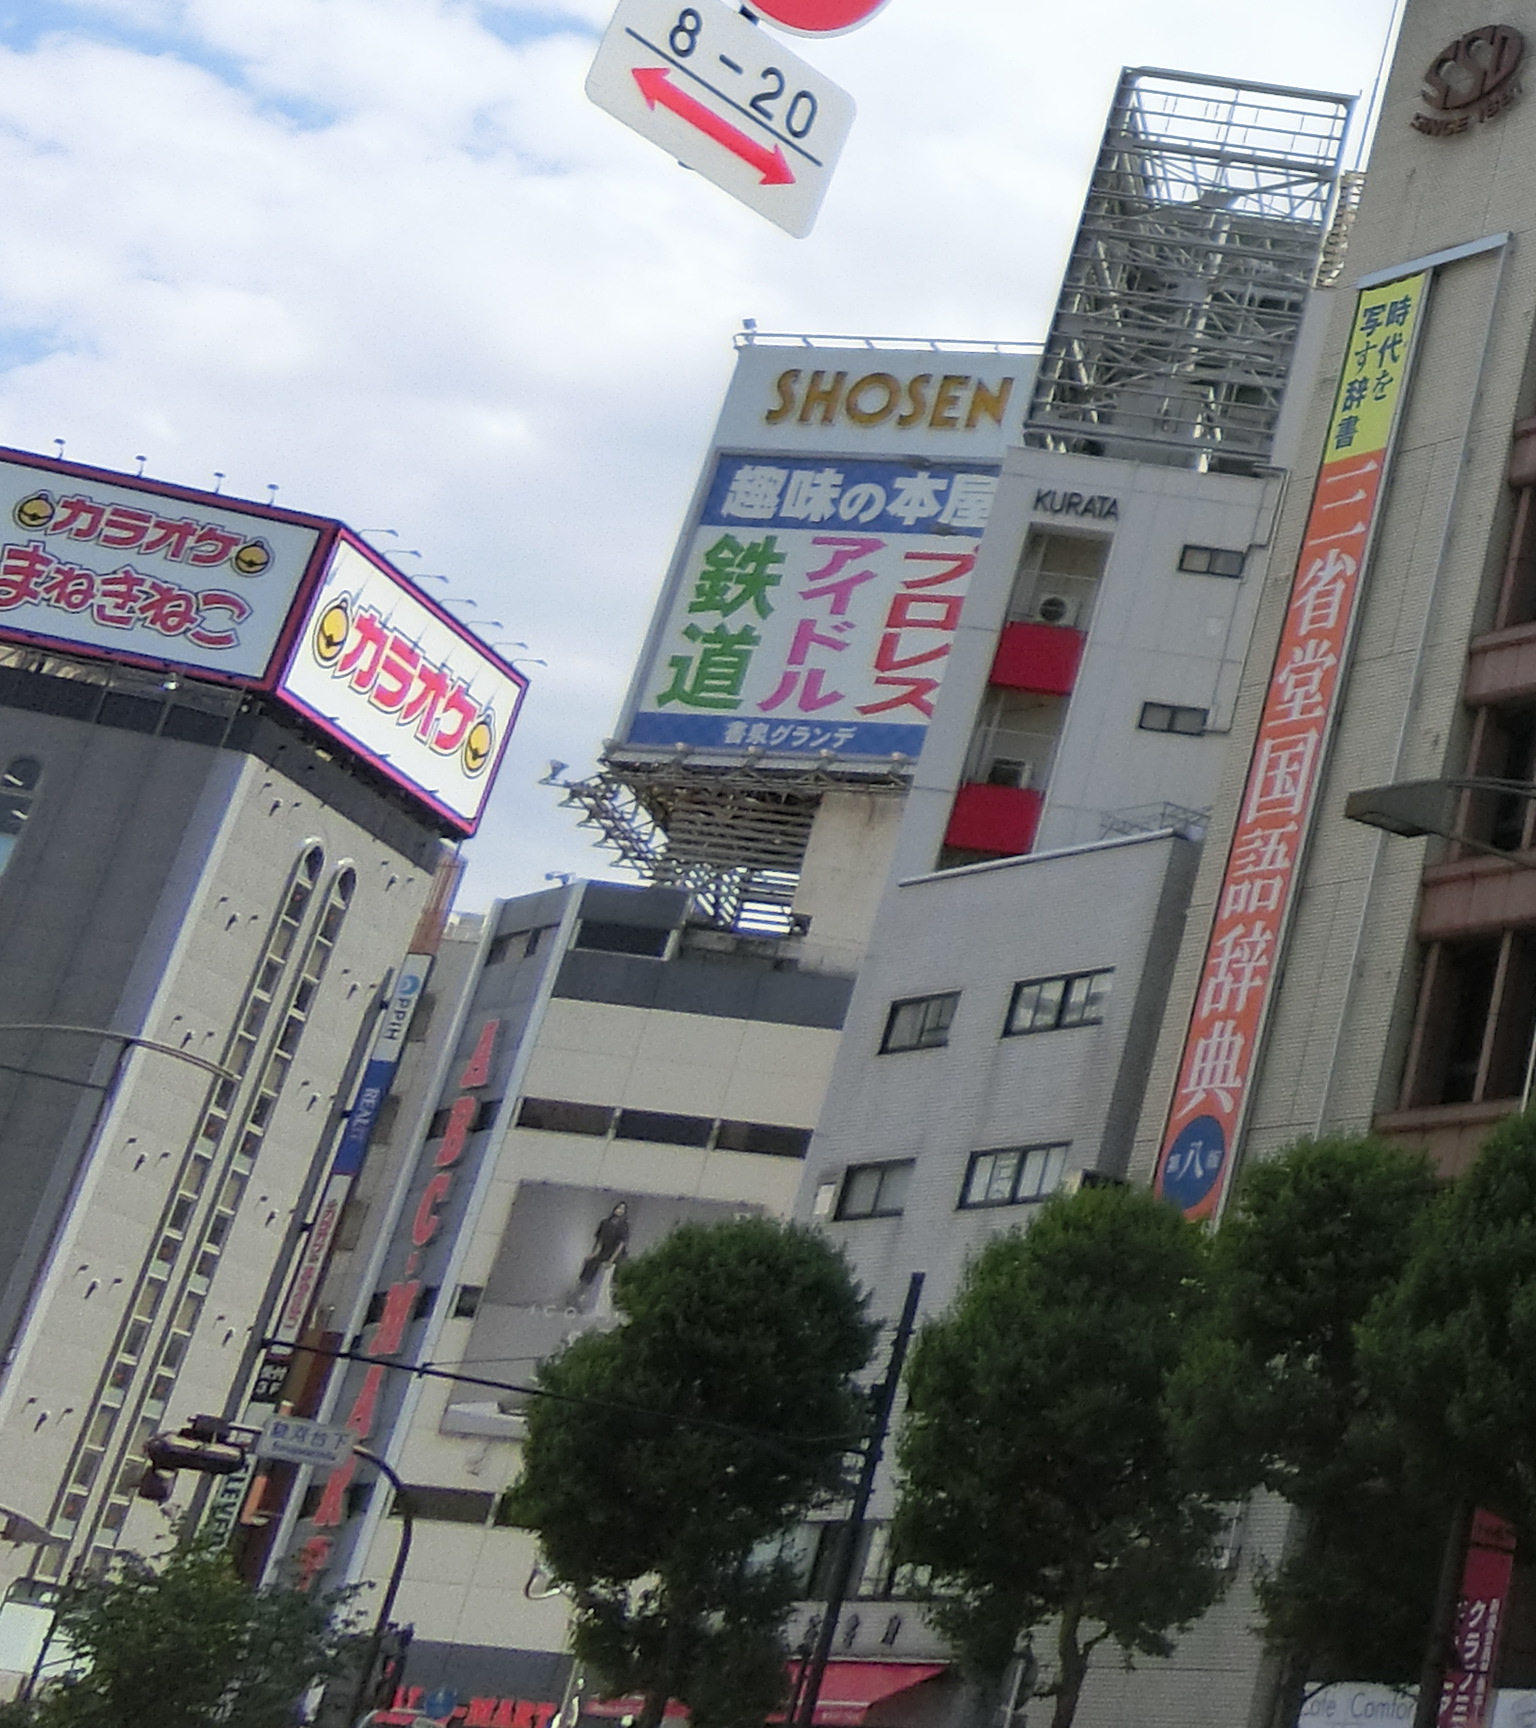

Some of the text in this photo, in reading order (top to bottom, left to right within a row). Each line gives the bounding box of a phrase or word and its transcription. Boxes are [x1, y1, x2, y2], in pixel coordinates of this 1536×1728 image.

[766, 368, 1014, 429] SHOSEN
[1334, 302, 1386, 450] 写す辞書
[1369, 294, 1412, 401] 時代を
[50, 494, 245, 569] カラオケ
[721, 464, 996, 529] 趣味の本屋
[1033, 489, 1119, 521] KURATA
[0, 541, 253, 650] まねきねこ
[657, 533, 788, 710] 鉄道
[756, 536, 888, 713] アイドル
[336, 605, 480, 756] カラオケ
[723, 720, 857, 749] 書泉グランデ
[1175, 458, 1379, 1116] 三省堂国語辞典
[383, 997, 413, 1041] PPIH
